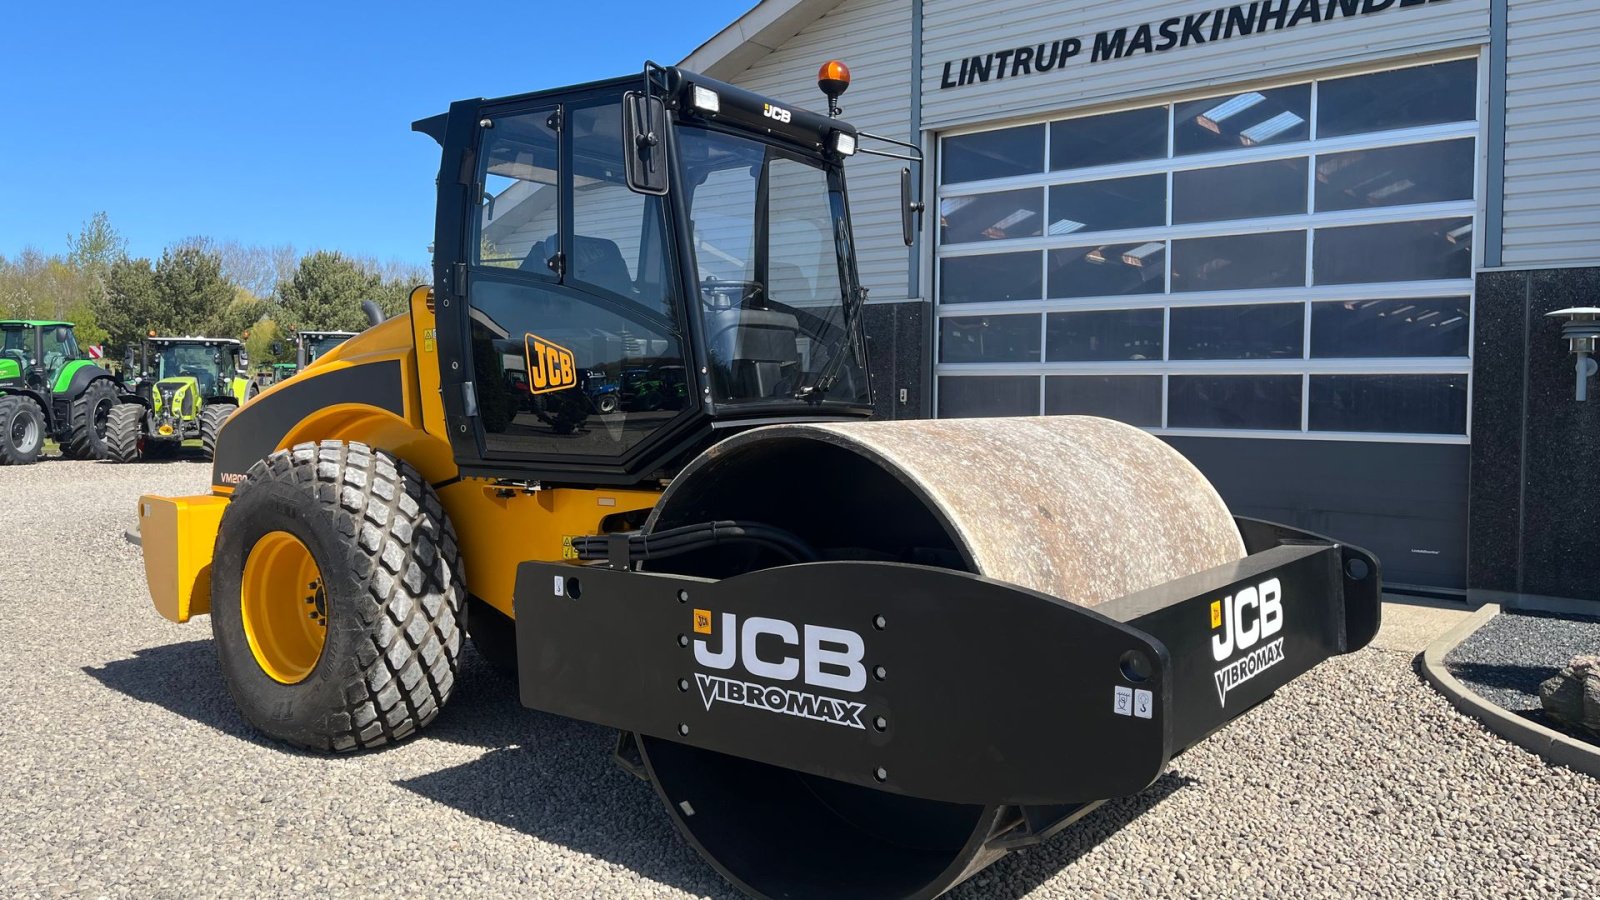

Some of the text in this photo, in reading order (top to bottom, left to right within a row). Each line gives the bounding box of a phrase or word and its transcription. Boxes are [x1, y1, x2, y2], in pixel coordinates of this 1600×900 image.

[940, 38, 1082, 89] LINTRUP
[763, 103, 791, 123] JCB
[532, 341, 573, 388] JCB
[1210, 577, 1283, 662] JCB
[693, 612, 867, 693] JCB
[1213, 636, 1285, 708] VIBROMAX
[694, 672, 867, 730] VIBROMAX
